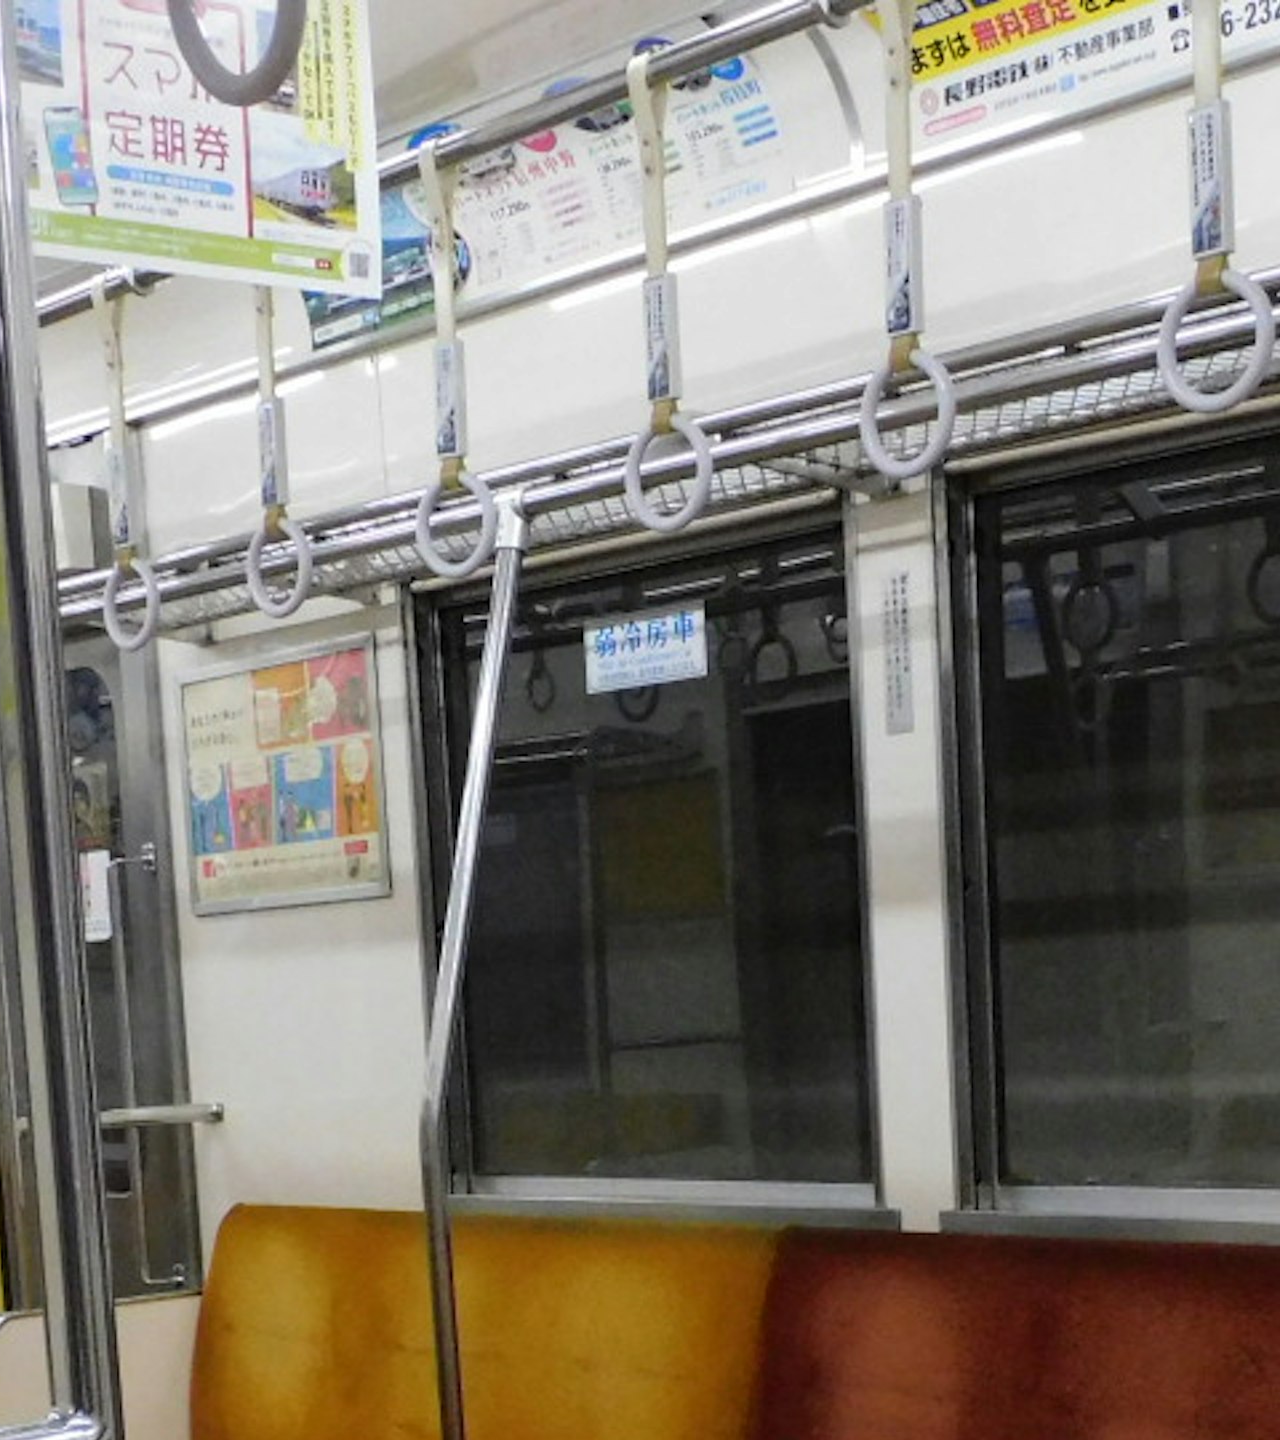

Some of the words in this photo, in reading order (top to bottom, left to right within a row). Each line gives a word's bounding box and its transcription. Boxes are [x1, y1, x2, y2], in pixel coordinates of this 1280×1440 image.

[1058, 16, 1155, 64] 不動産事業部
[105, 110, 230, 172] 定期券
[594, 609, 695, 657] 弱冷房車
